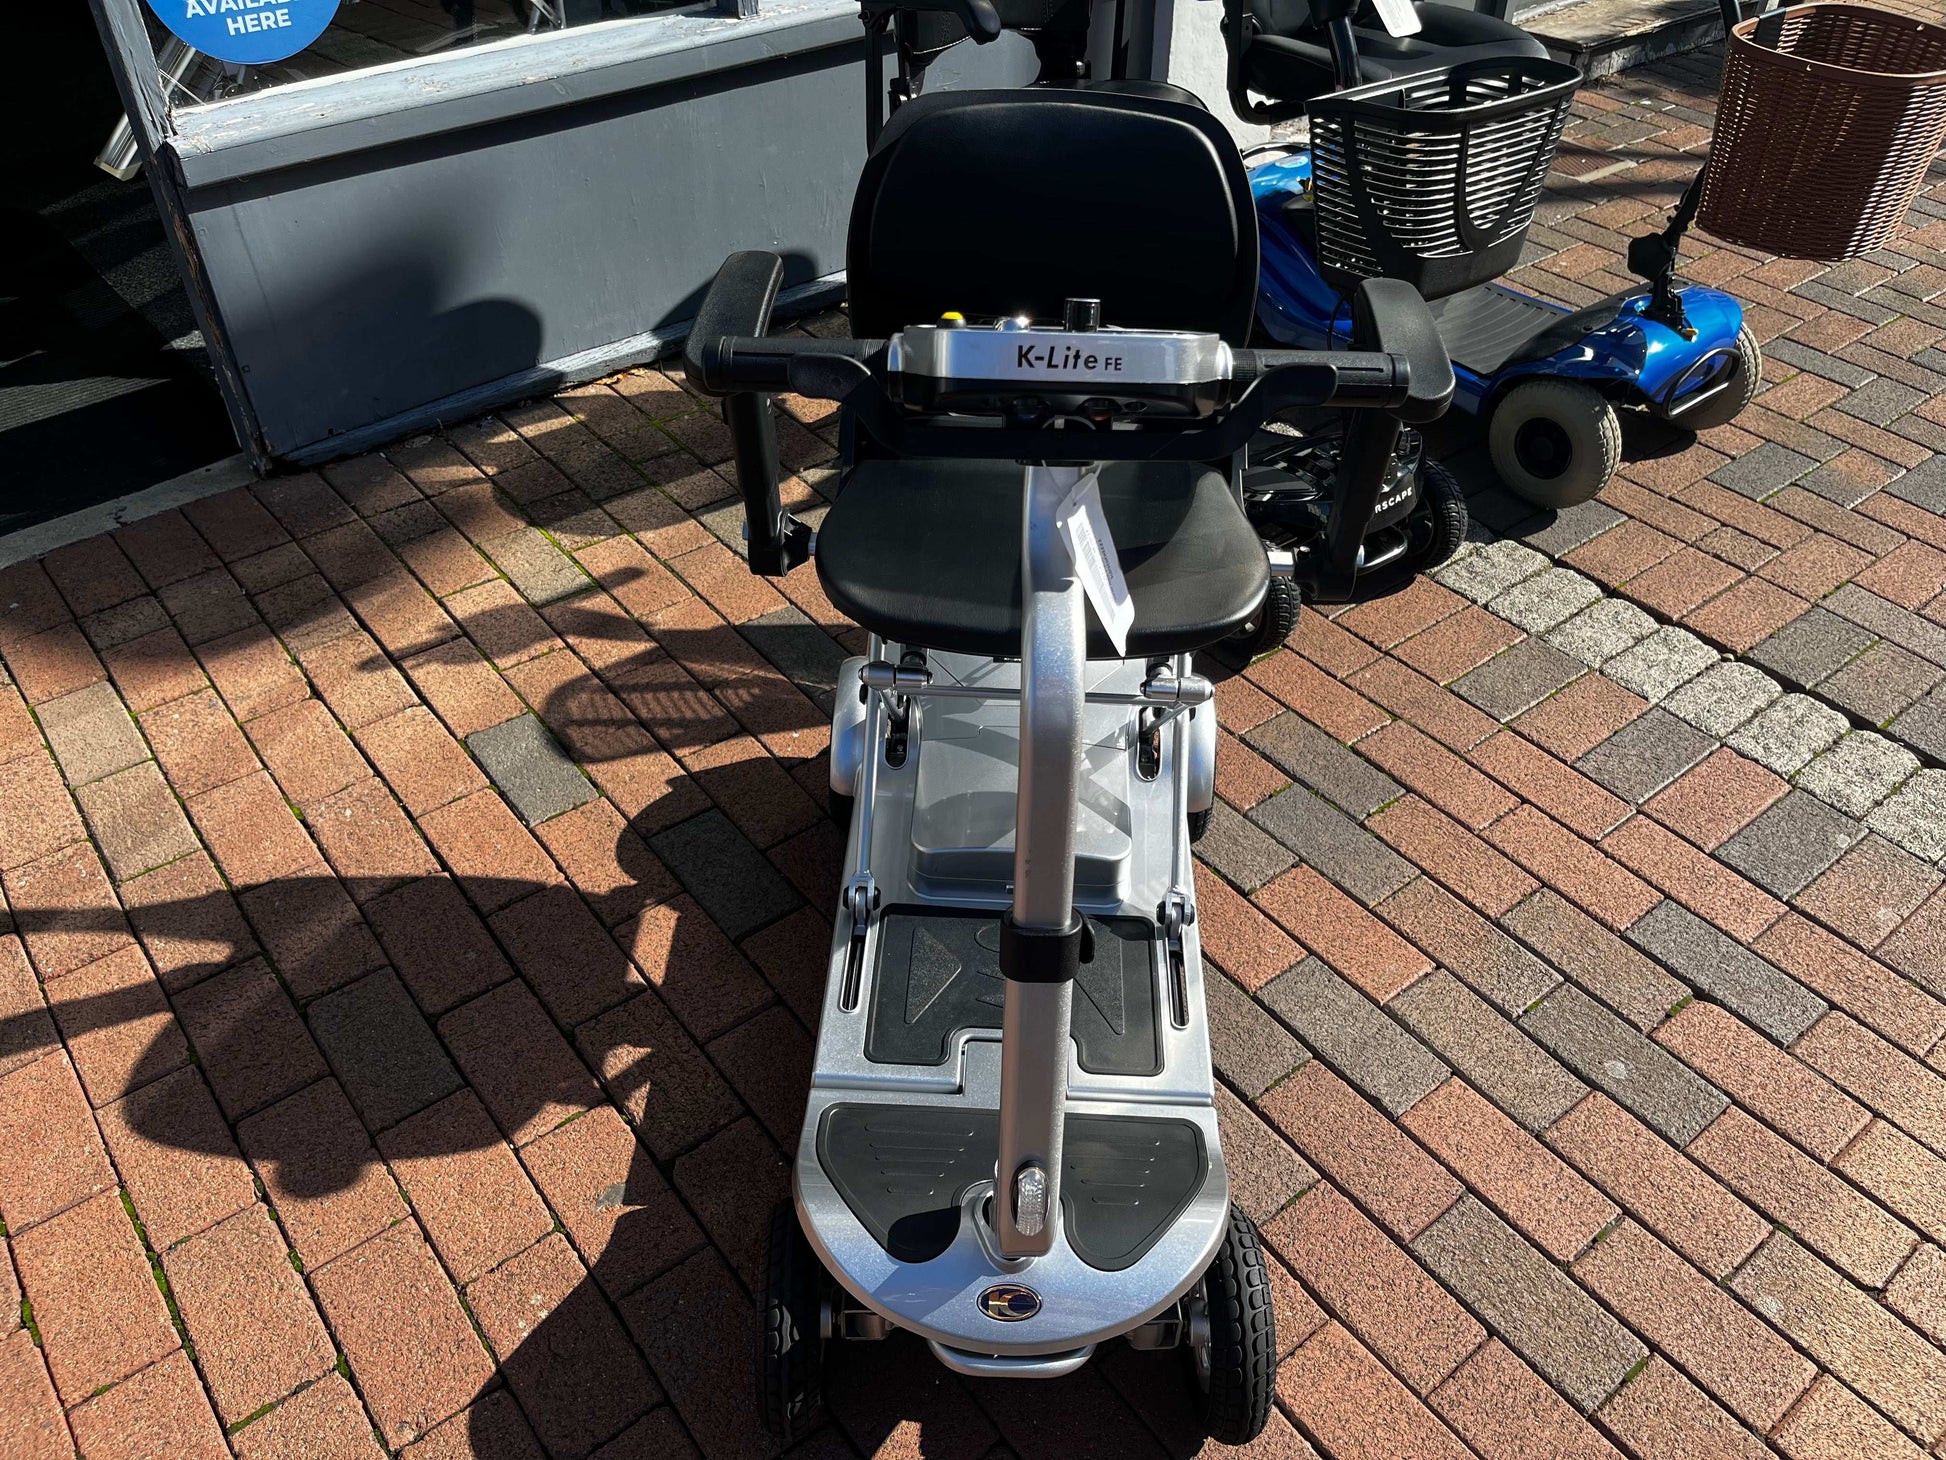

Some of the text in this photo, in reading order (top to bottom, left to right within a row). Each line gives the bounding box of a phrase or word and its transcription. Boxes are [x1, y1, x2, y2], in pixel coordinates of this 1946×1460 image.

[226, 8, 292, 36] HERE
[1017, 344, 1122, 371] K-Lite FE
[1374, 486, 1412, 514] RSCAPE
